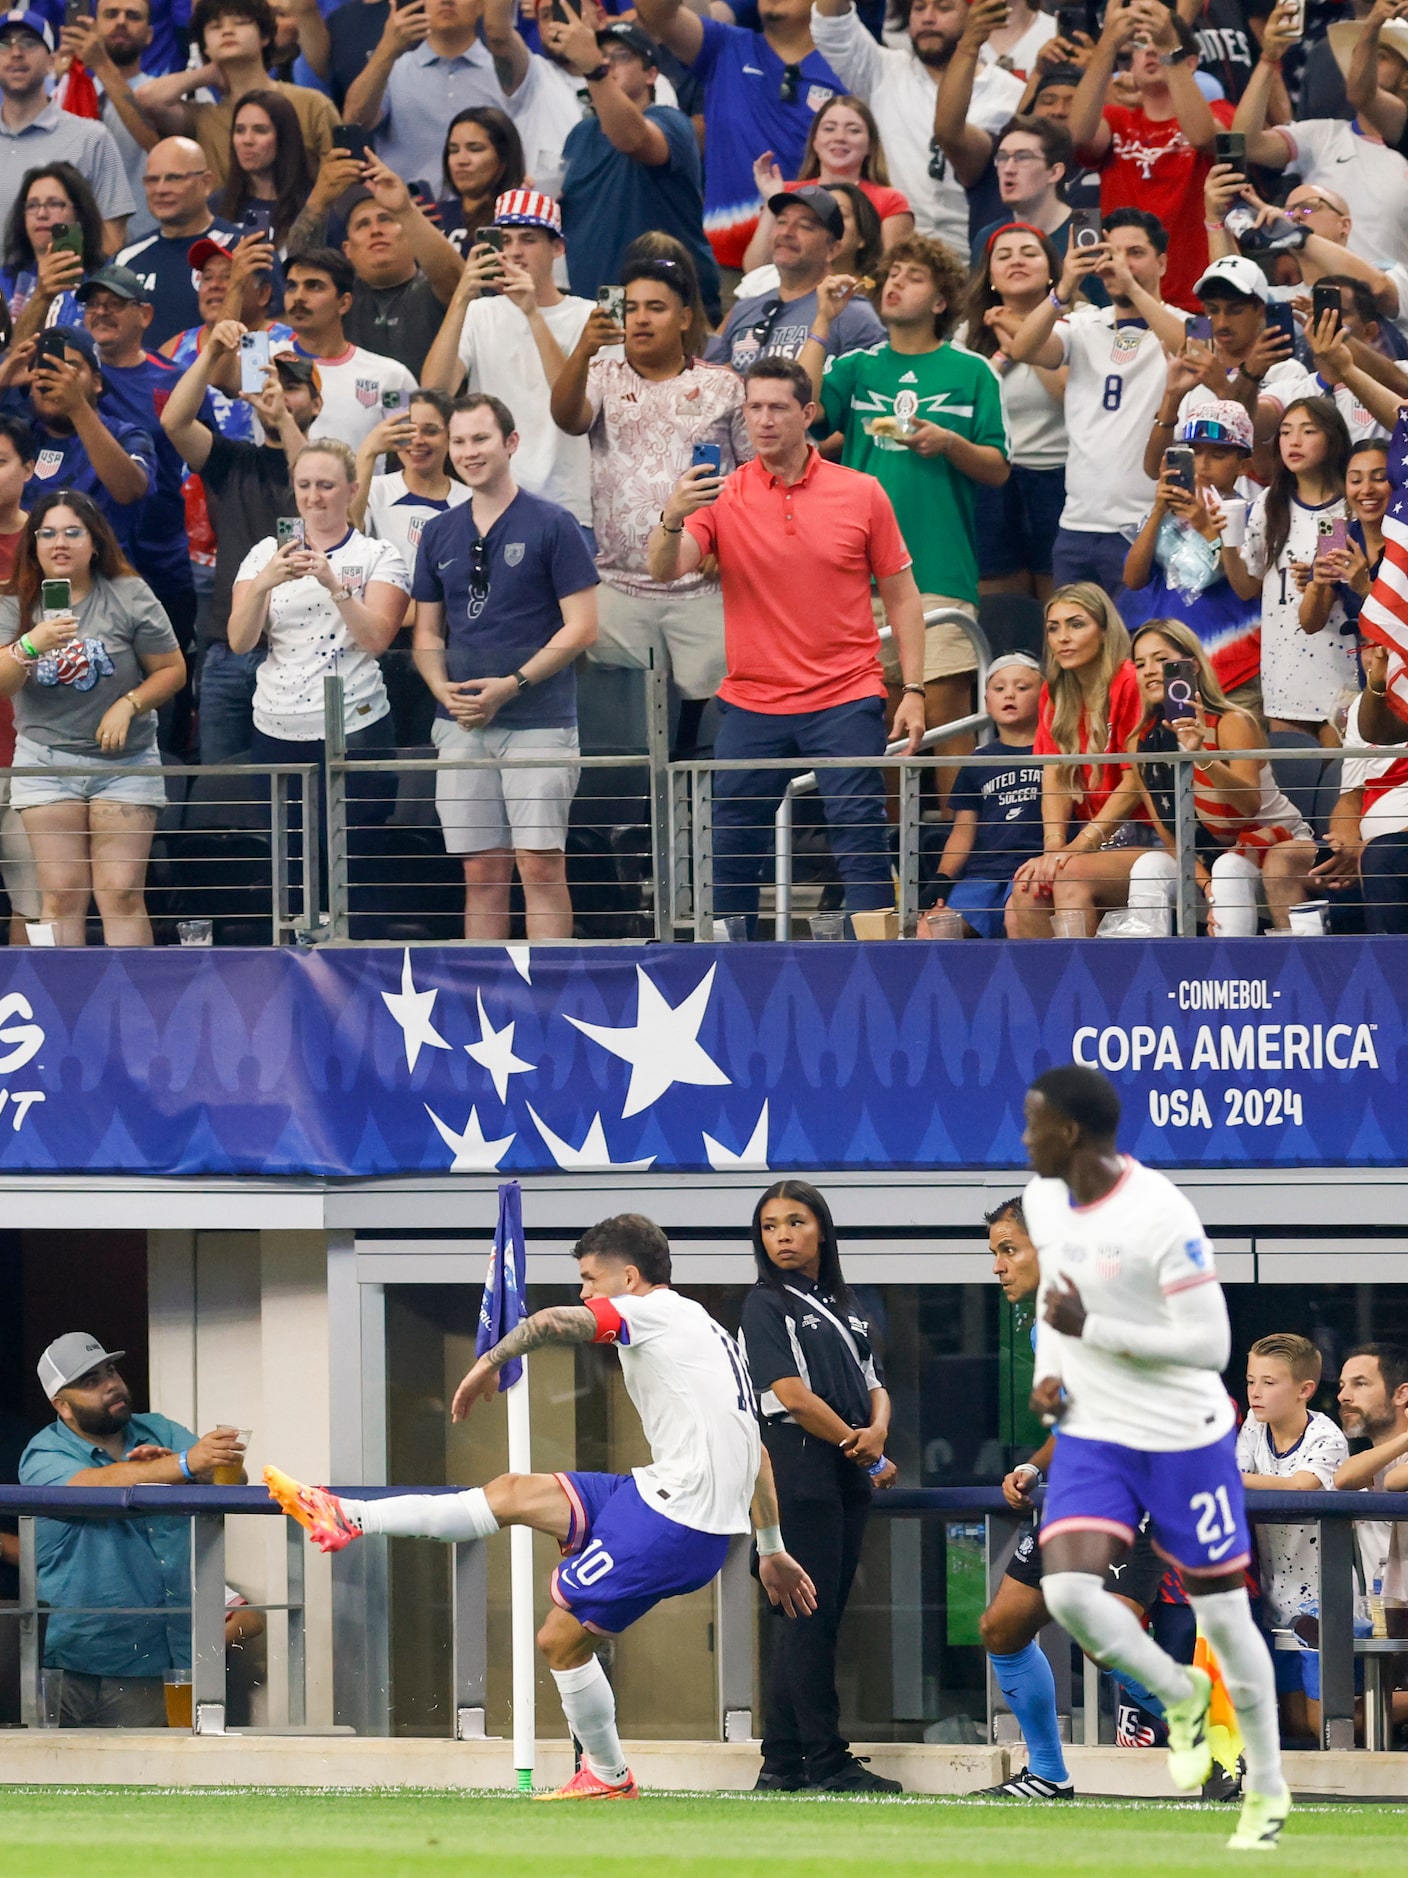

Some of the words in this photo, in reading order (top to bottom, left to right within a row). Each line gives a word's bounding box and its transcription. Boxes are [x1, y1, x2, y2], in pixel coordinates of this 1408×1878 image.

[772, 325, 809, 345] TEA
[1102, 374, 1123, 412] 8
[41, 450, 63, 464] USA
[998, 787, 1038, 806] SOCCER
[1072, 1025, 1184, 1071] COPA
[1149, 1089, 1212, 1129] USA
[1224, 1087, 1304, 1128] 2024
[1189, 1485, 1237, 1545] 21
[571, 1538, 615, 1587] 10
